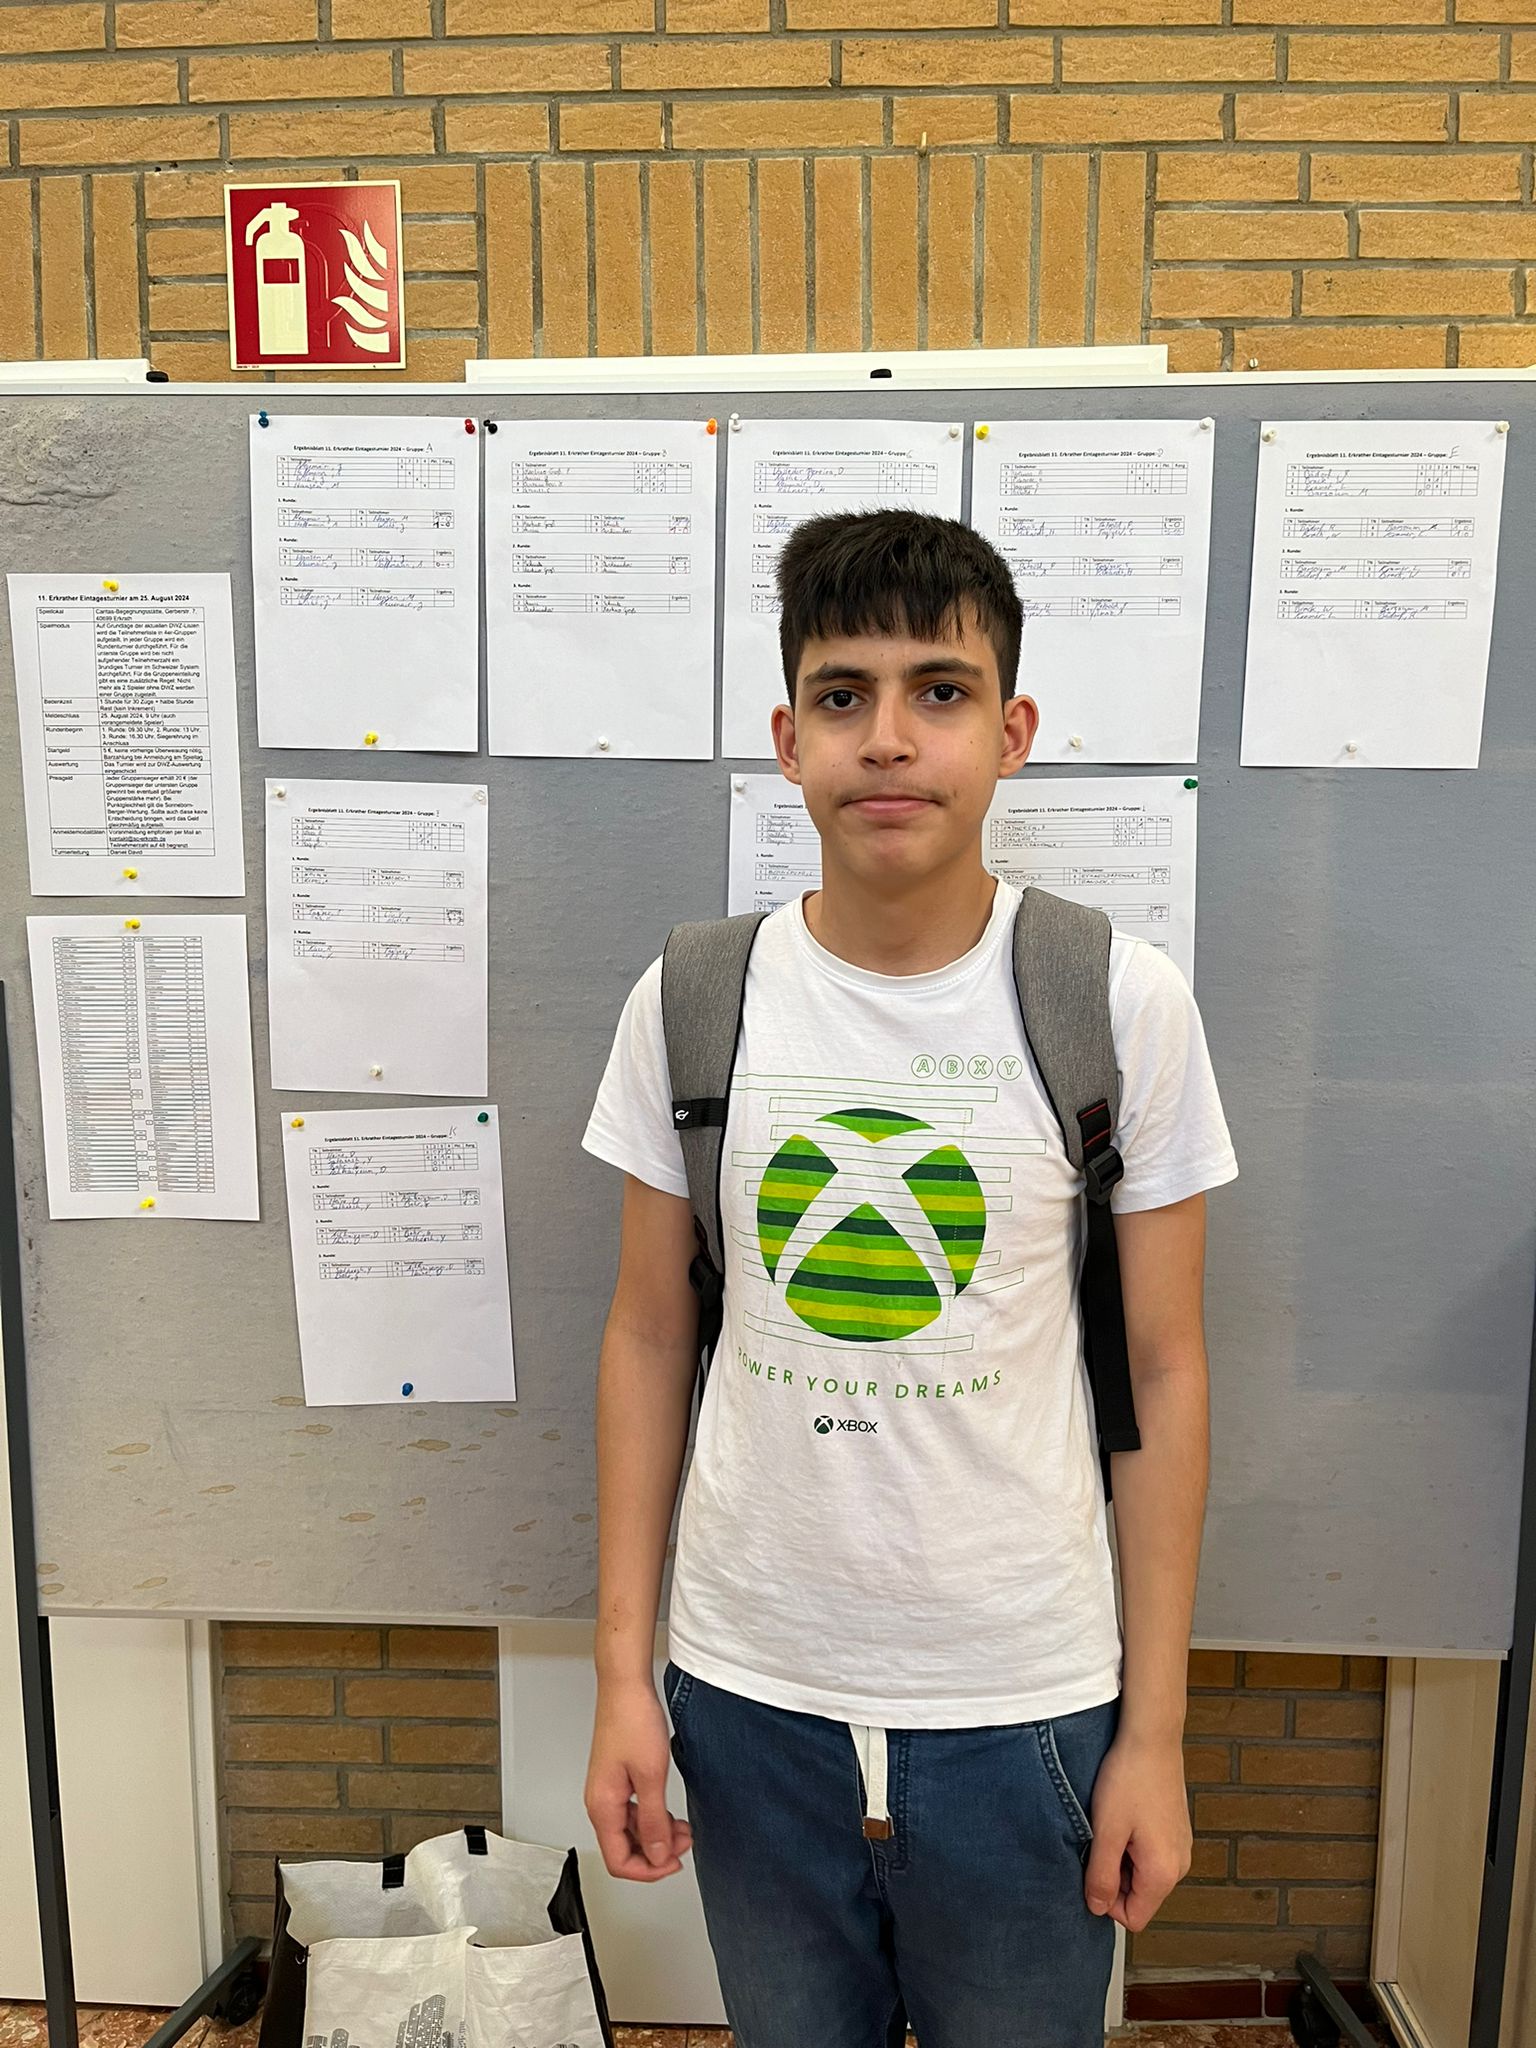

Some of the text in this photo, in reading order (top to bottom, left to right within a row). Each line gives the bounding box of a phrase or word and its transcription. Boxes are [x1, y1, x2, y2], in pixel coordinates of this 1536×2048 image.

[79, 595, 128, 603] Eintagesturnier
[150, 595, 174, 603] August
[806, 1375, 877, 1396] YOUR
[895, 1369, 1000, 1399] DREAMS
[836, 1419, 878, 1434] XBOX
